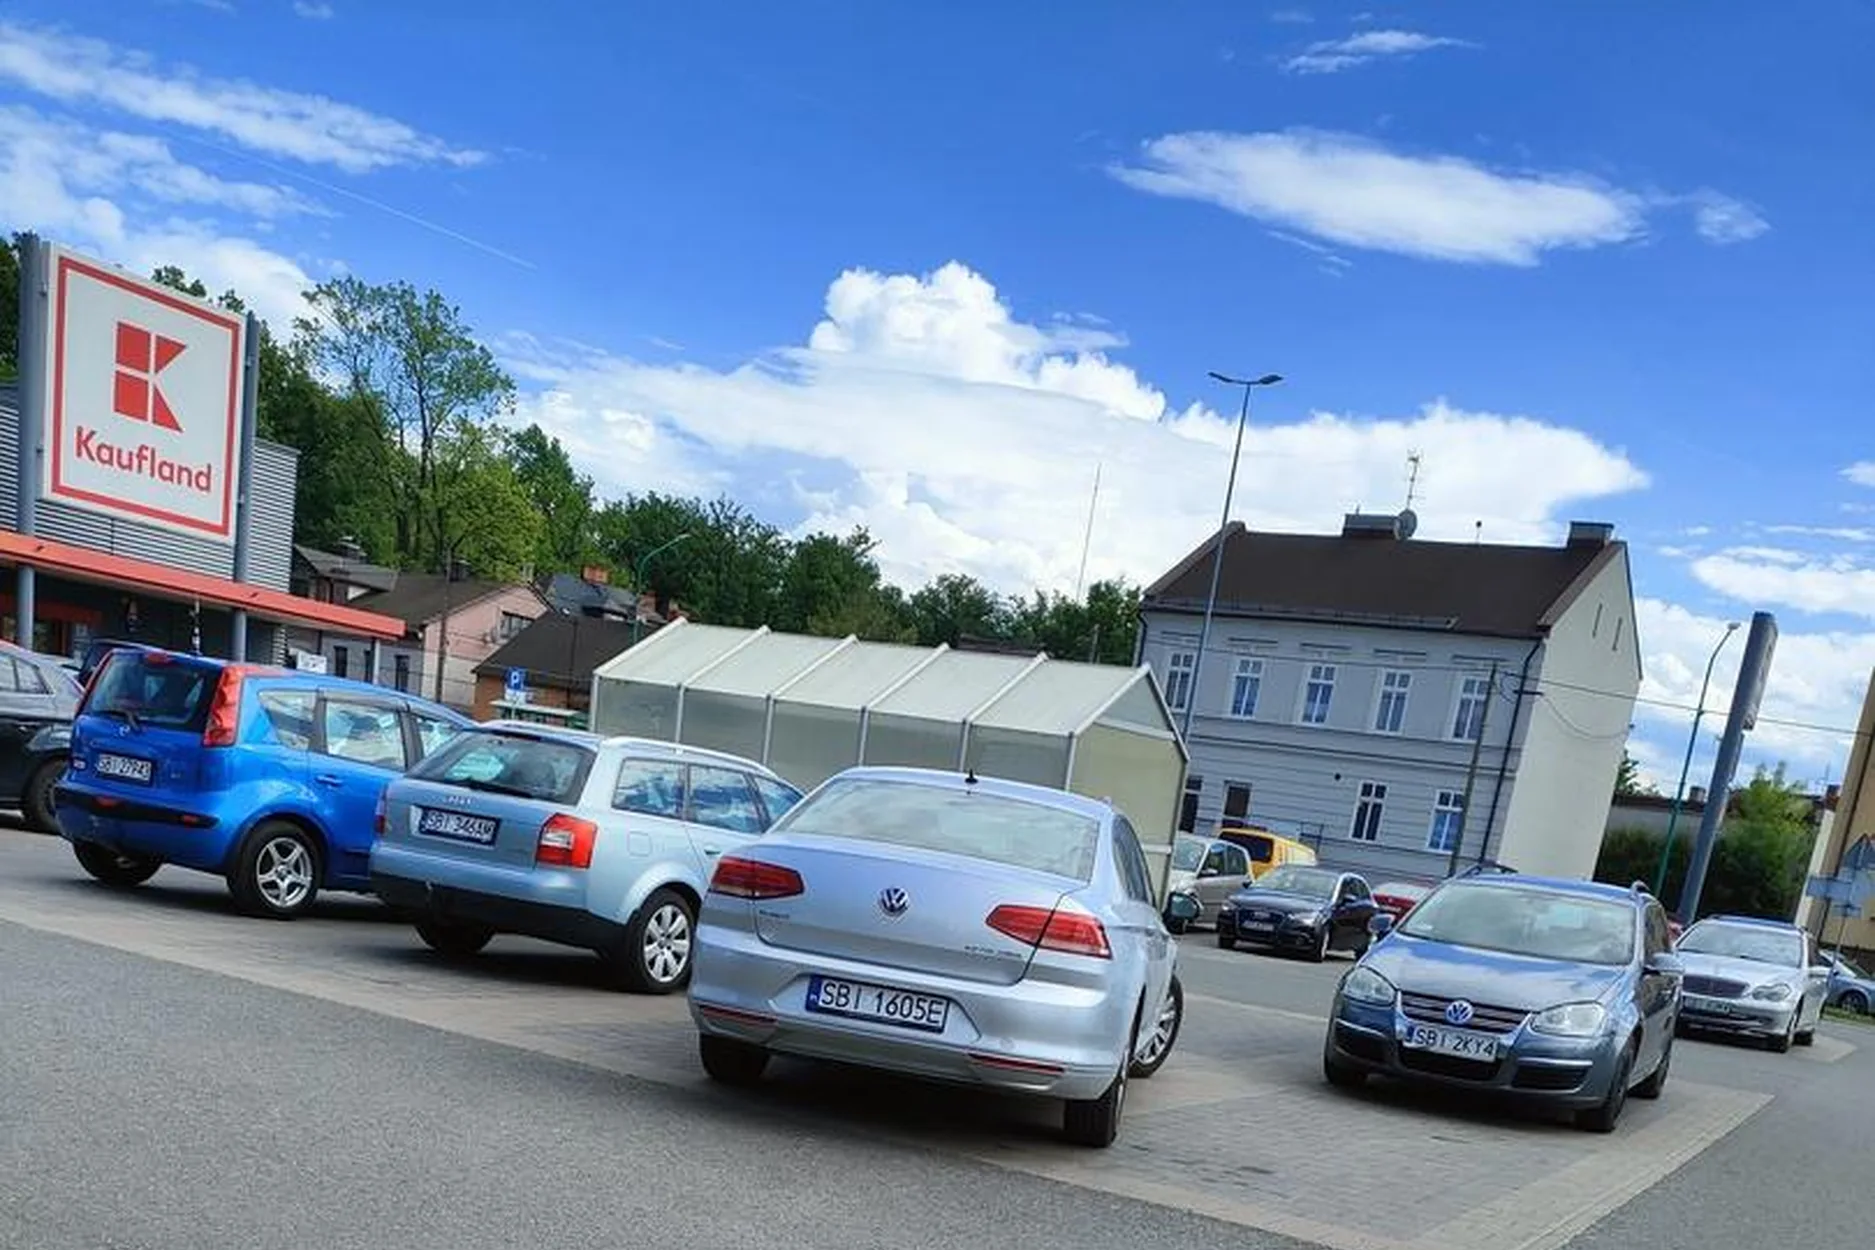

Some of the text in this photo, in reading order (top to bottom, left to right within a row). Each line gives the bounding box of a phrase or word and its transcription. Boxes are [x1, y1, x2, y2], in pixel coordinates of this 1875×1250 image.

[75, 425, 213, 492] Kaufland
[821, 982, 943, 1023] SBI 1605E
[1416, 1028, 1447, 1047] SBI
